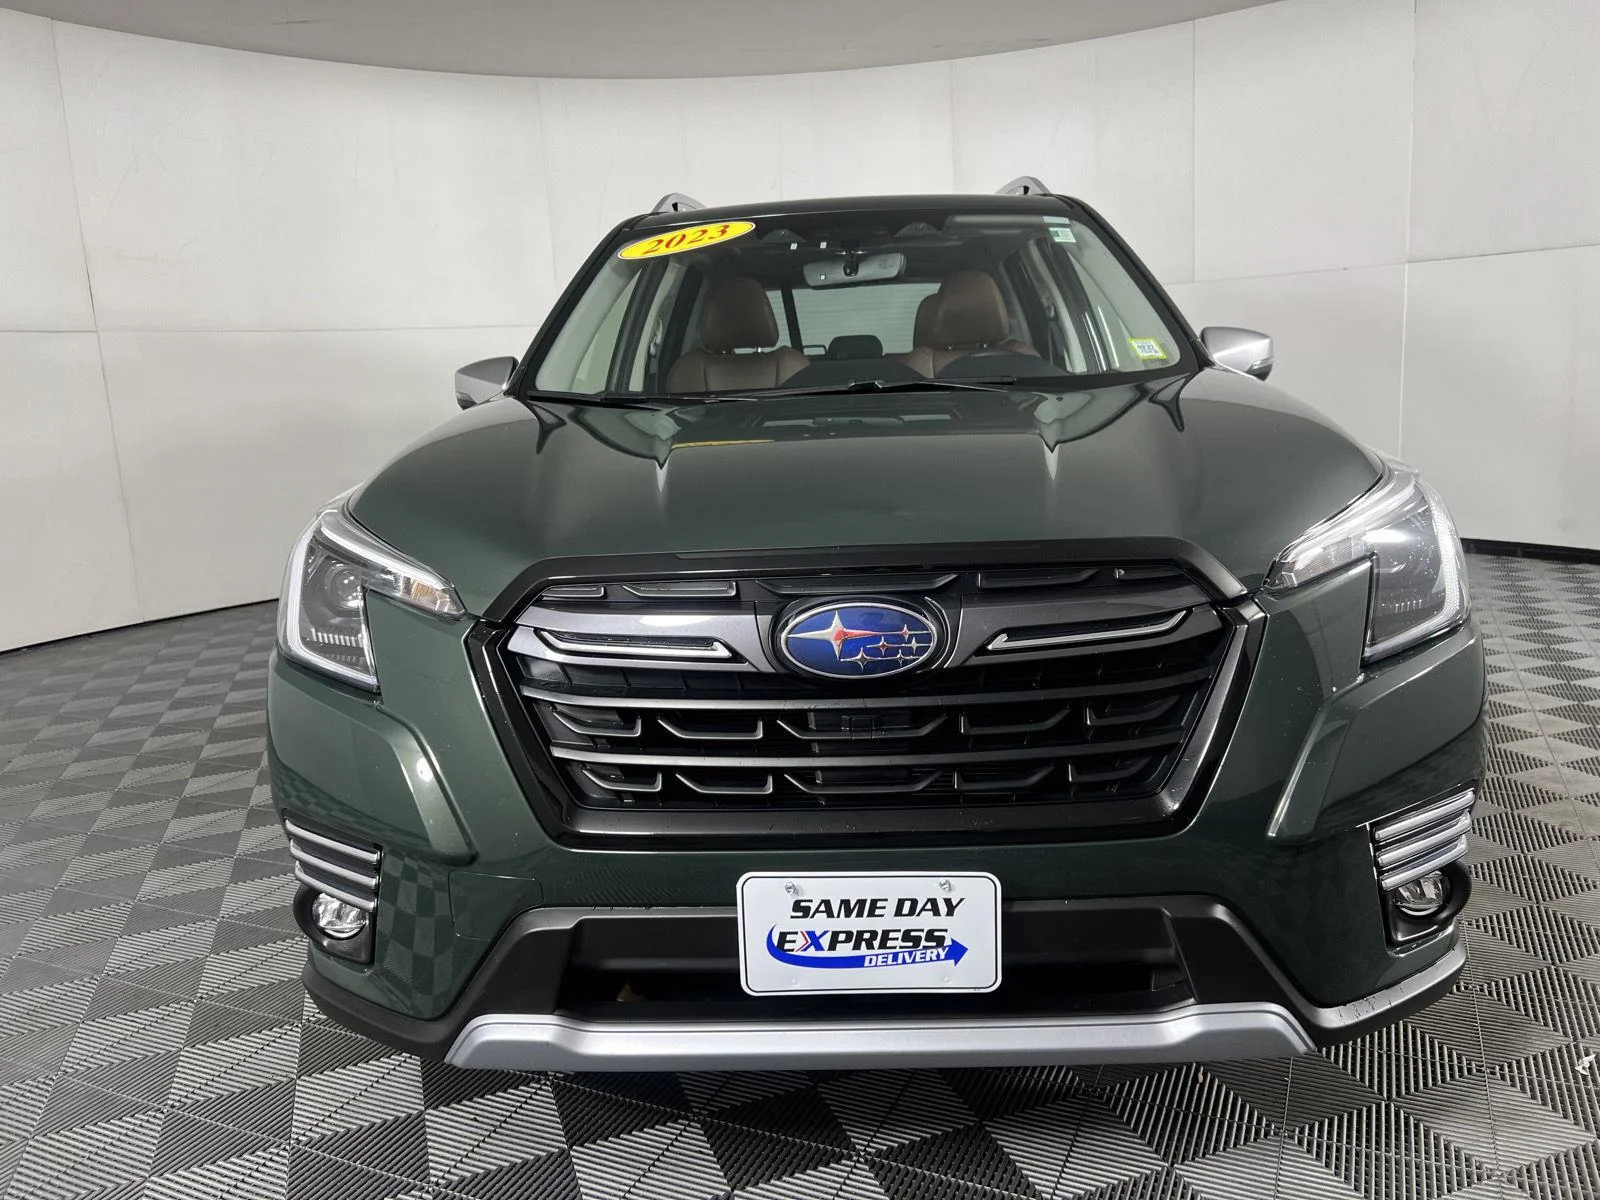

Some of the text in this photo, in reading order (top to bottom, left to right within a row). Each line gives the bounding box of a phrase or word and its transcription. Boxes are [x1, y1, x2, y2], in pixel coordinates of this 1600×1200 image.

[643, 224, 730, 254] 2023
[790, 897, 966, 919] SAME DAY
[776, 928, 949, 952] EXPRESS
[864, 947, 949, 967] DELIVERY
